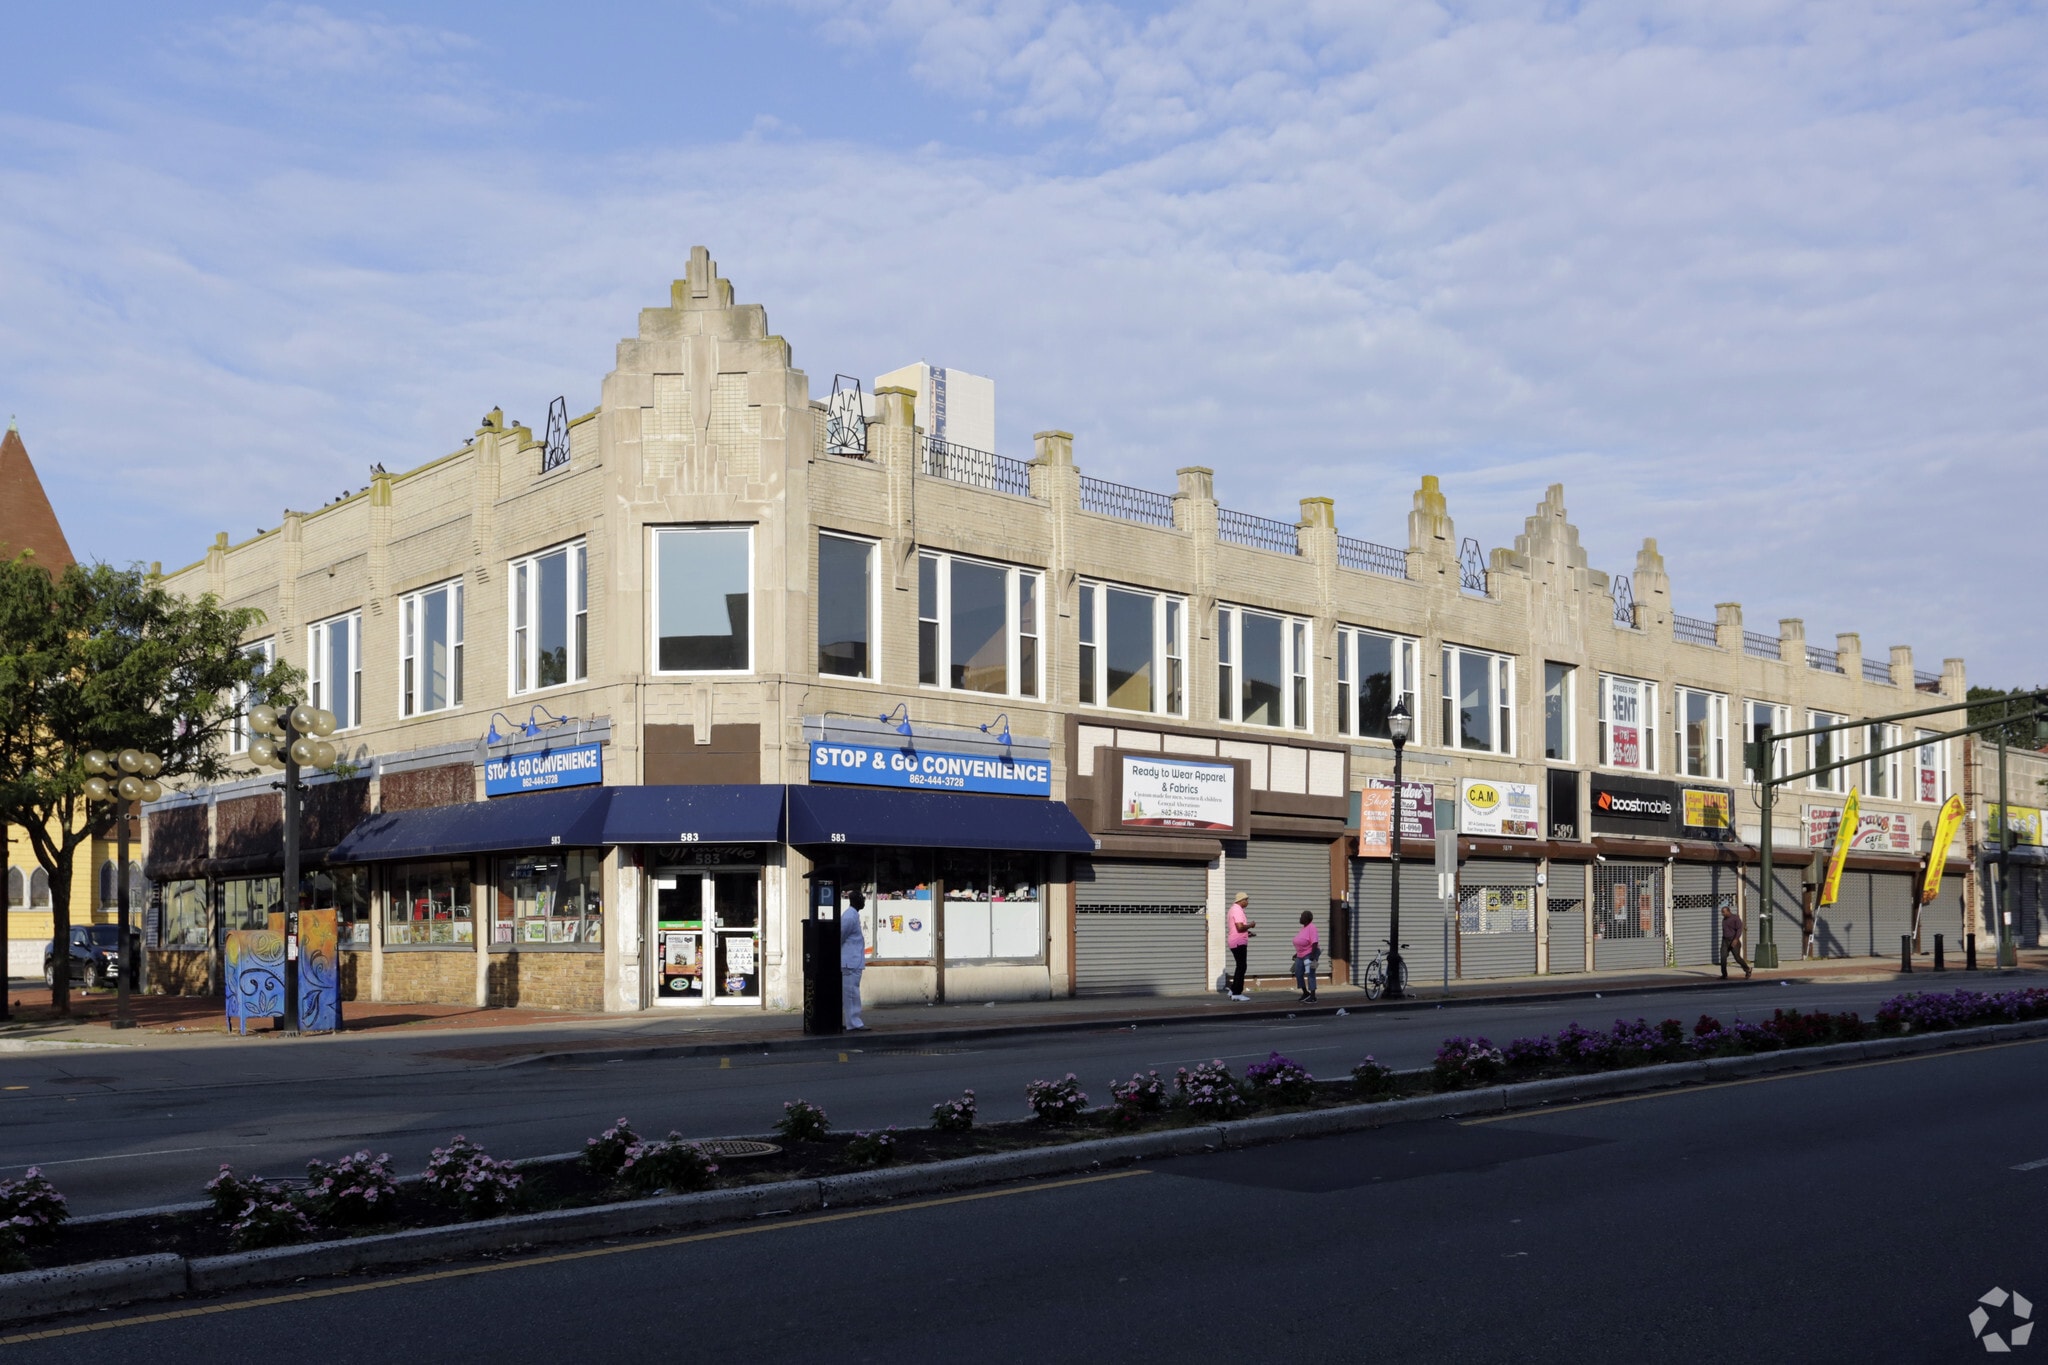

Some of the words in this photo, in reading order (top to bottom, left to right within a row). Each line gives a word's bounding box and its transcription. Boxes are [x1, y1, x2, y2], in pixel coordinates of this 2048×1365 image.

[1628, 687, 1637, 695] FOR
[1613, 694, 1637, 723] RENT
[487, 762, 508, 781] STOP
[510, 761, 517, 778] &
[518, 758, 531, 776] GO
[532, 749, 597, 775] CONVENIENCE
[815, 747, 868, 768] STOP
[872, 752, 886, 770] &
[891, 754, 919, 772] GO
[922, 756, 1047, 783] CONVENIENCE
[522, 774, 558, 787] 862-444-3728
[909, 774, 965, 787] 862-444-3728
[1132, 765, 1160, 780] Ready
[1161, 768, 1170, 778] to
[1171, 769, 1193, 780] Wear
[1194, 770, 1227, 783] Apparel
[1161, 782, 1168, 792] &
[1169, 782, 1199, 794] Fabrics
[1363, 792, 1390, 808] Shop
[1469, 789, 1496, 803] C.A.M.
[1703, 794, 1728, 809] NAILS
[1611, 796, 1672, 815] boostmobile
[680, 833, 699, 841] 583
[831, 833, 845, 841] 583
[1554, 823, 1573, 839] 589
[551, 836, 560, 845] 583
[695, 853, 721, 865] 583
[821, 887, 832, 904] P
